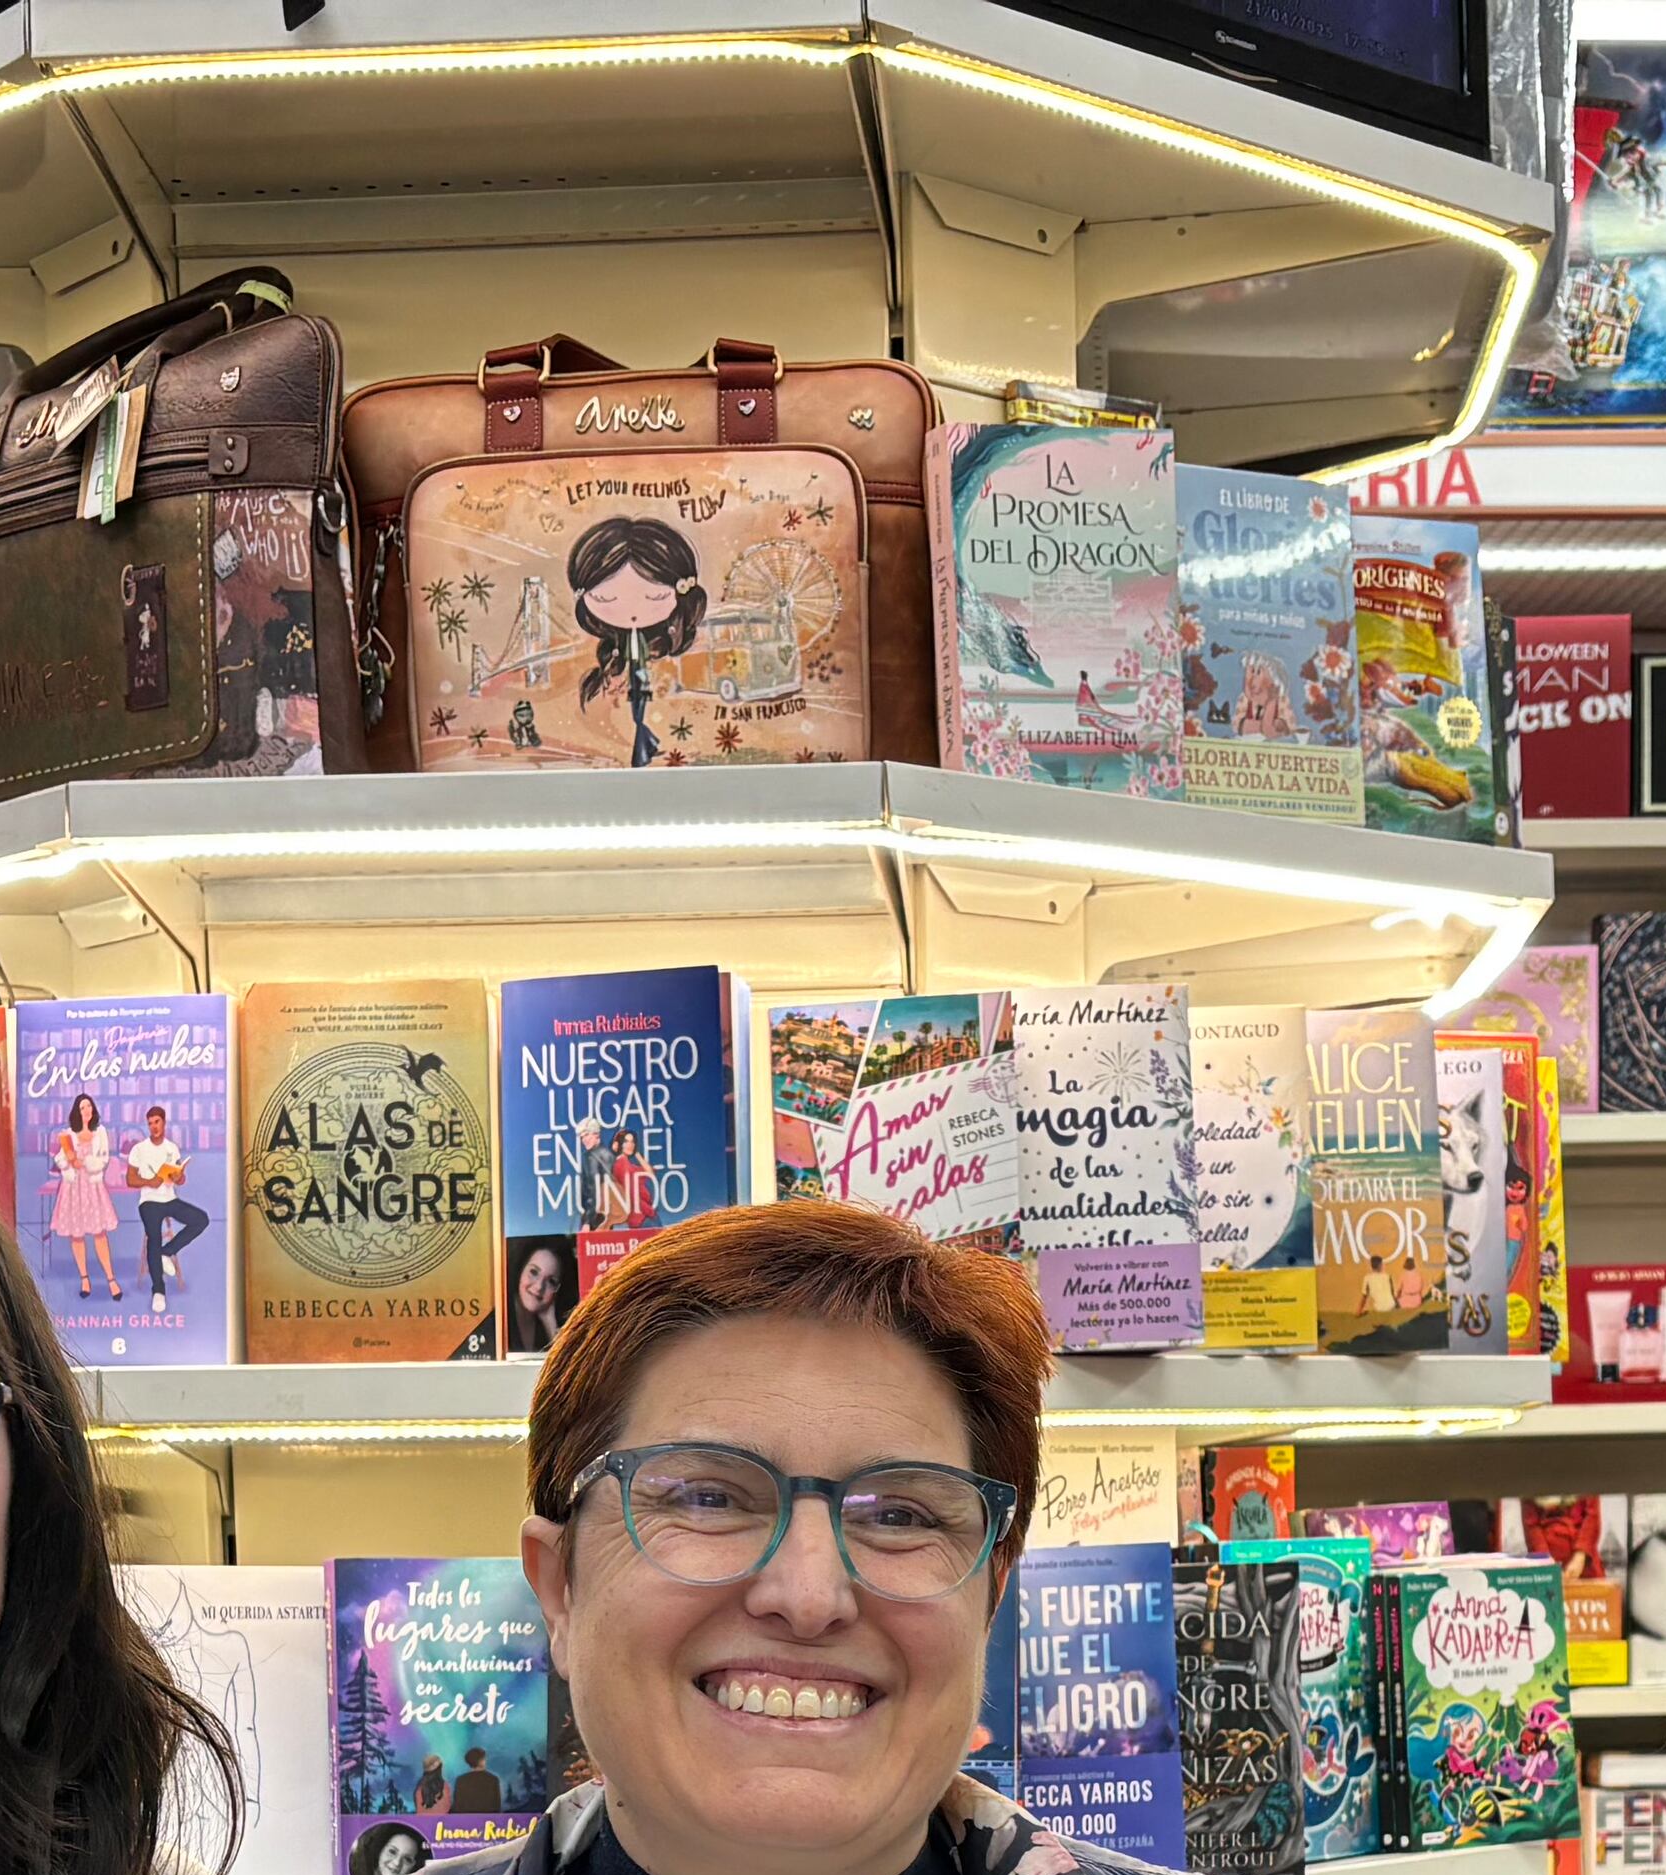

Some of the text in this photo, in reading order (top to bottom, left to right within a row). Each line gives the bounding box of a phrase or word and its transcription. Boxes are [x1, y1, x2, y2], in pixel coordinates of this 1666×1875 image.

[1046, 454, 1083, 496] LA
[632, 478, 691, 499] FEELINGS
[1220, 488, 1290, 513] EL DE
[678, 489, 727, 523] FLOW
[992, 493, 1145, 535] PROMESA
[971, 534, 1169, 576] DEL DRAGÓN
[1019, 730, 1105, 746] ELIZABETH
[1255, 754, 1340, 774] FUERTES
[1223, 774, 1350, 796] TODA LA VIDA
[554, 1013, 661, 1036] Inma Rubiales
[1068, 998, 1169, 1027] Martínez
[28, 1025, 215, 1098] En las nubes
[521, 1035, 699, 1088] NUESTRO
[1048, 1070, 1083, 1095] La
[548, 1083, 674, 1131] LUGAR
[948, 1107, 999, 1130] REBECA
[269, 1101, 415, 1151] ALAS
[1016, 1095, 1158, 1148] magia
[952, 1124, 1005, 1147] STONES
[1084, 1155, 1123, 1178] las
[263, 1173, 476, 1224] SANGRE
[537, 1170, 689, 1218] MUNDO
[1063, 1276, 1113, 1299] María
[1118, 1272, 1192, 1295] Martínez
[263, 1298, 481, 1318] REBECCA YARROS
[1077, 1297, 1171, 1312] Más de 500.000
[53, 1314, 185, 1328] HANNAH GRACE
[1147, 1313, 1179, 1325] hacen
[407, 1581, 454, 1607] Todos
[1040, 1582, 1164, 1628] FUERTE
[1451, 1591, 1507, 1619] Anna
[201, 1606, 273, 1622] MI QUERIDA
[363, 1600, 536, 1661] lugares que
[413, 1649, 533, 1673] mantuvimos
[1082, 1633, 1121, 1674] EL
[416, 1684, 442, 1696] en
[399, 1683, 515, 1726] secreto
[1080, 1780, 1153, 1804] YARROS
[435, 1821, 481, 1840] Inma
[1117, 1835, 1154, 1849] ESPAÑA
